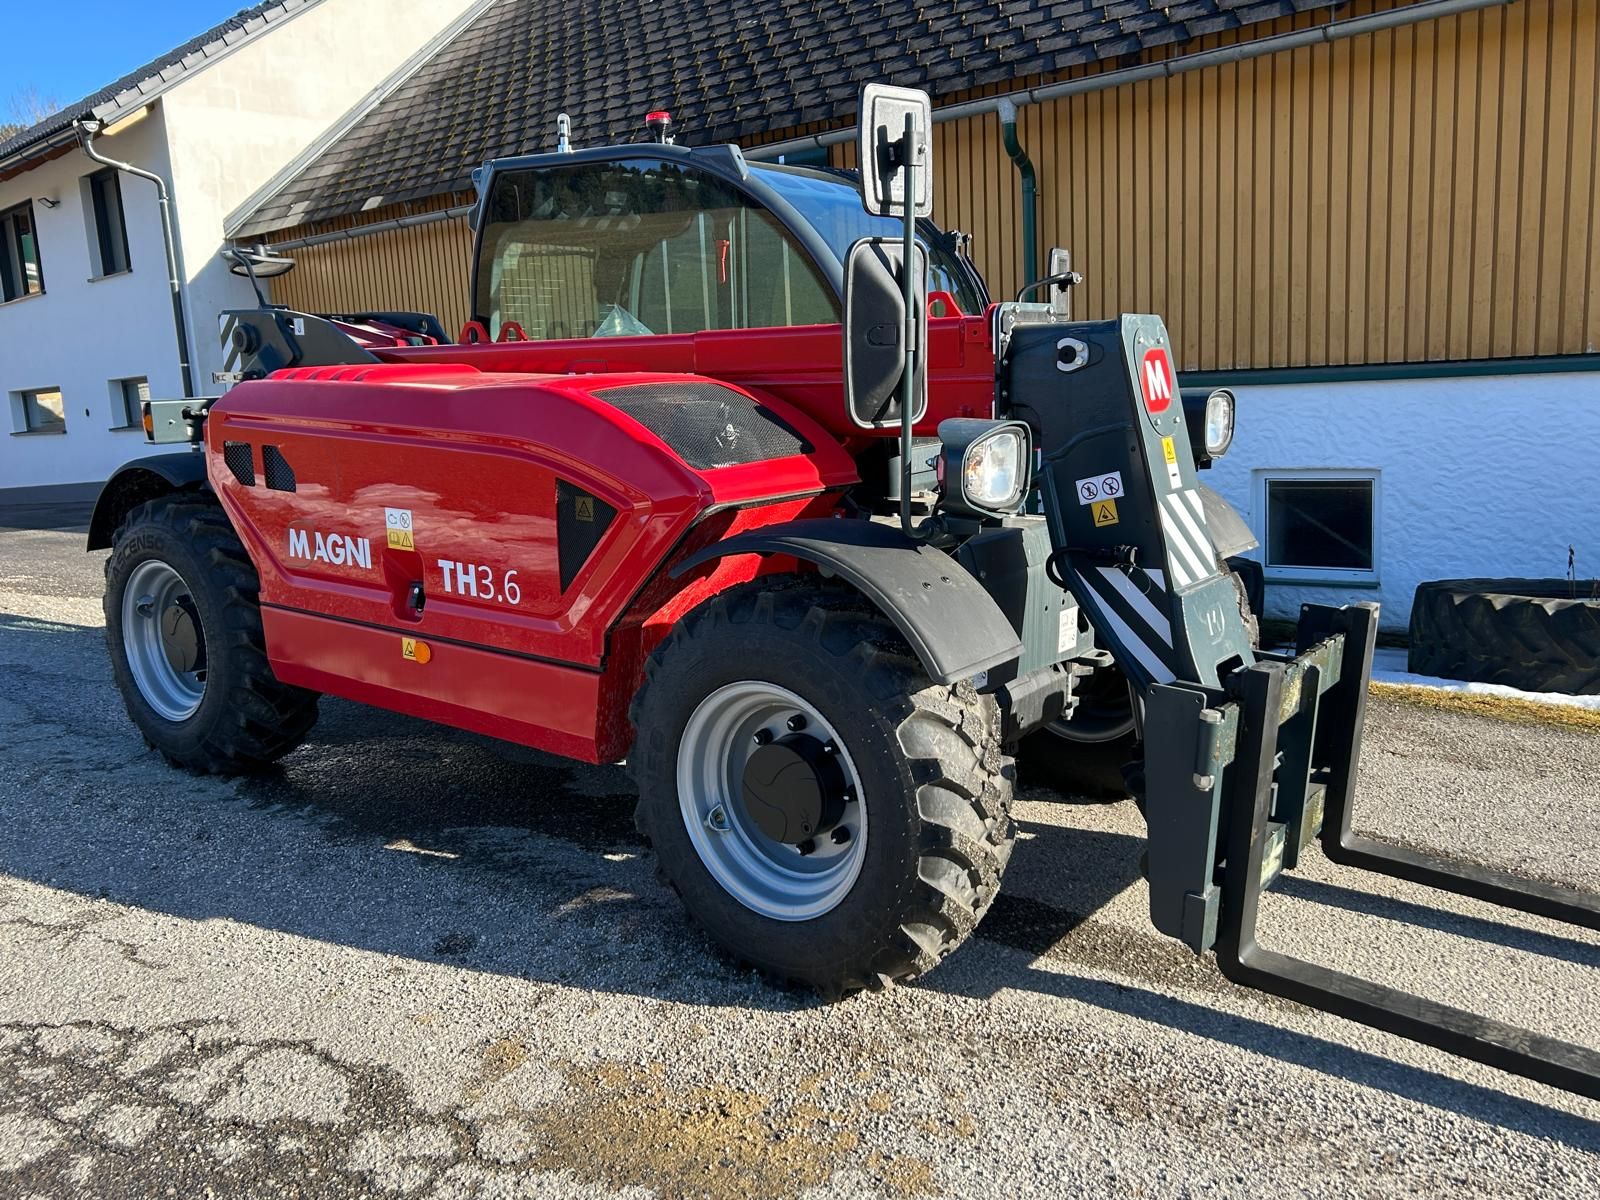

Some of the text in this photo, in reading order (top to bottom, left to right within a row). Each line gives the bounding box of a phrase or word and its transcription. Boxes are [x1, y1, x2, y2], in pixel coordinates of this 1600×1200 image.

[1144, 359, 1171, 401] M
[288, 528, 372, 569] MAGNI
[437, 559, 521, 605] TH3.6
